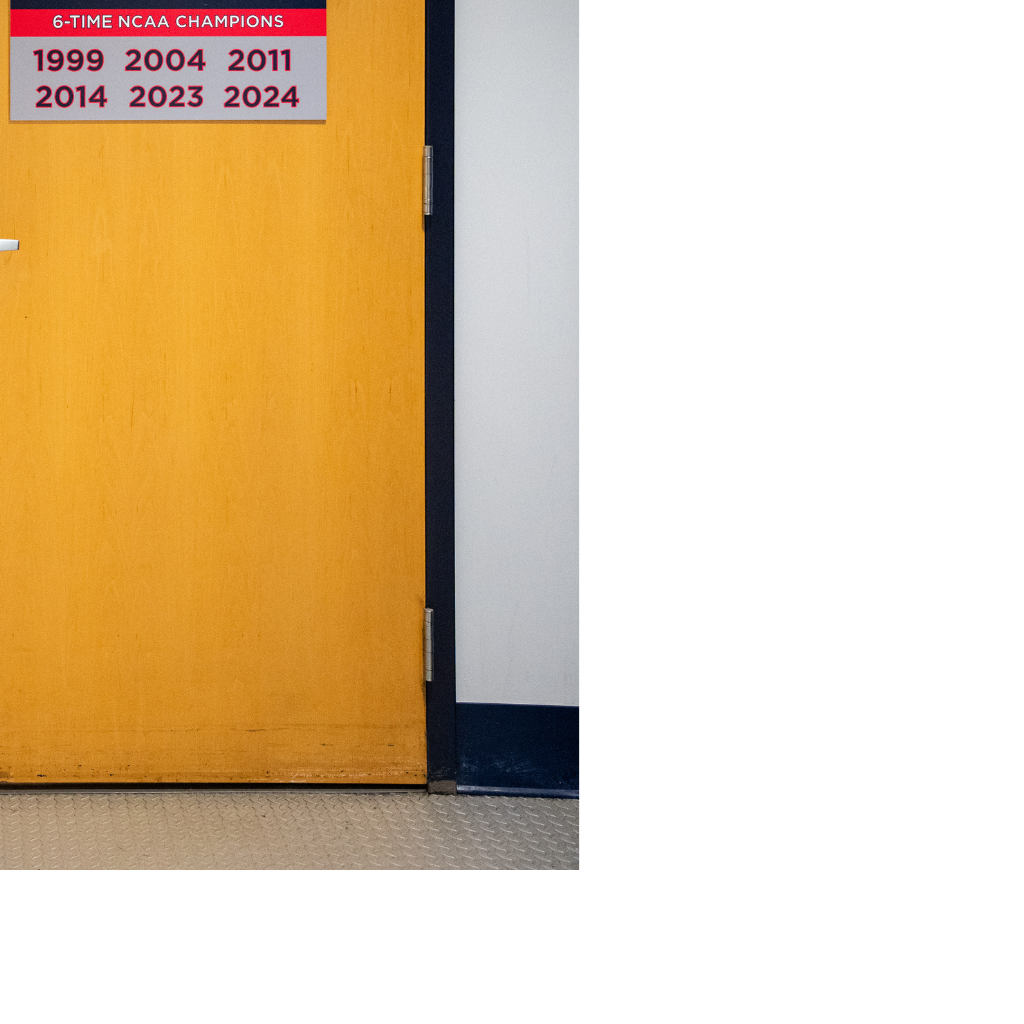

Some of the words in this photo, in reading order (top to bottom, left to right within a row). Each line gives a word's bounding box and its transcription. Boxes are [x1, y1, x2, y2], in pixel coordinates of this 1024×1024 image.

[52, 14, 112, 29] 6-TIME
[118, 14, 170, 28] NCAA
[175, 14, 284, 28] CHAMPIONS
[33, 48, 104, 72] 1999
[125, 48, 206, 72] 2004
[228, 48, 292, 72] 2011
[36, 85, 108, 108] 2014
[129, 85, 204, 108] 2023
[224, 85, 300, 108] 2024
